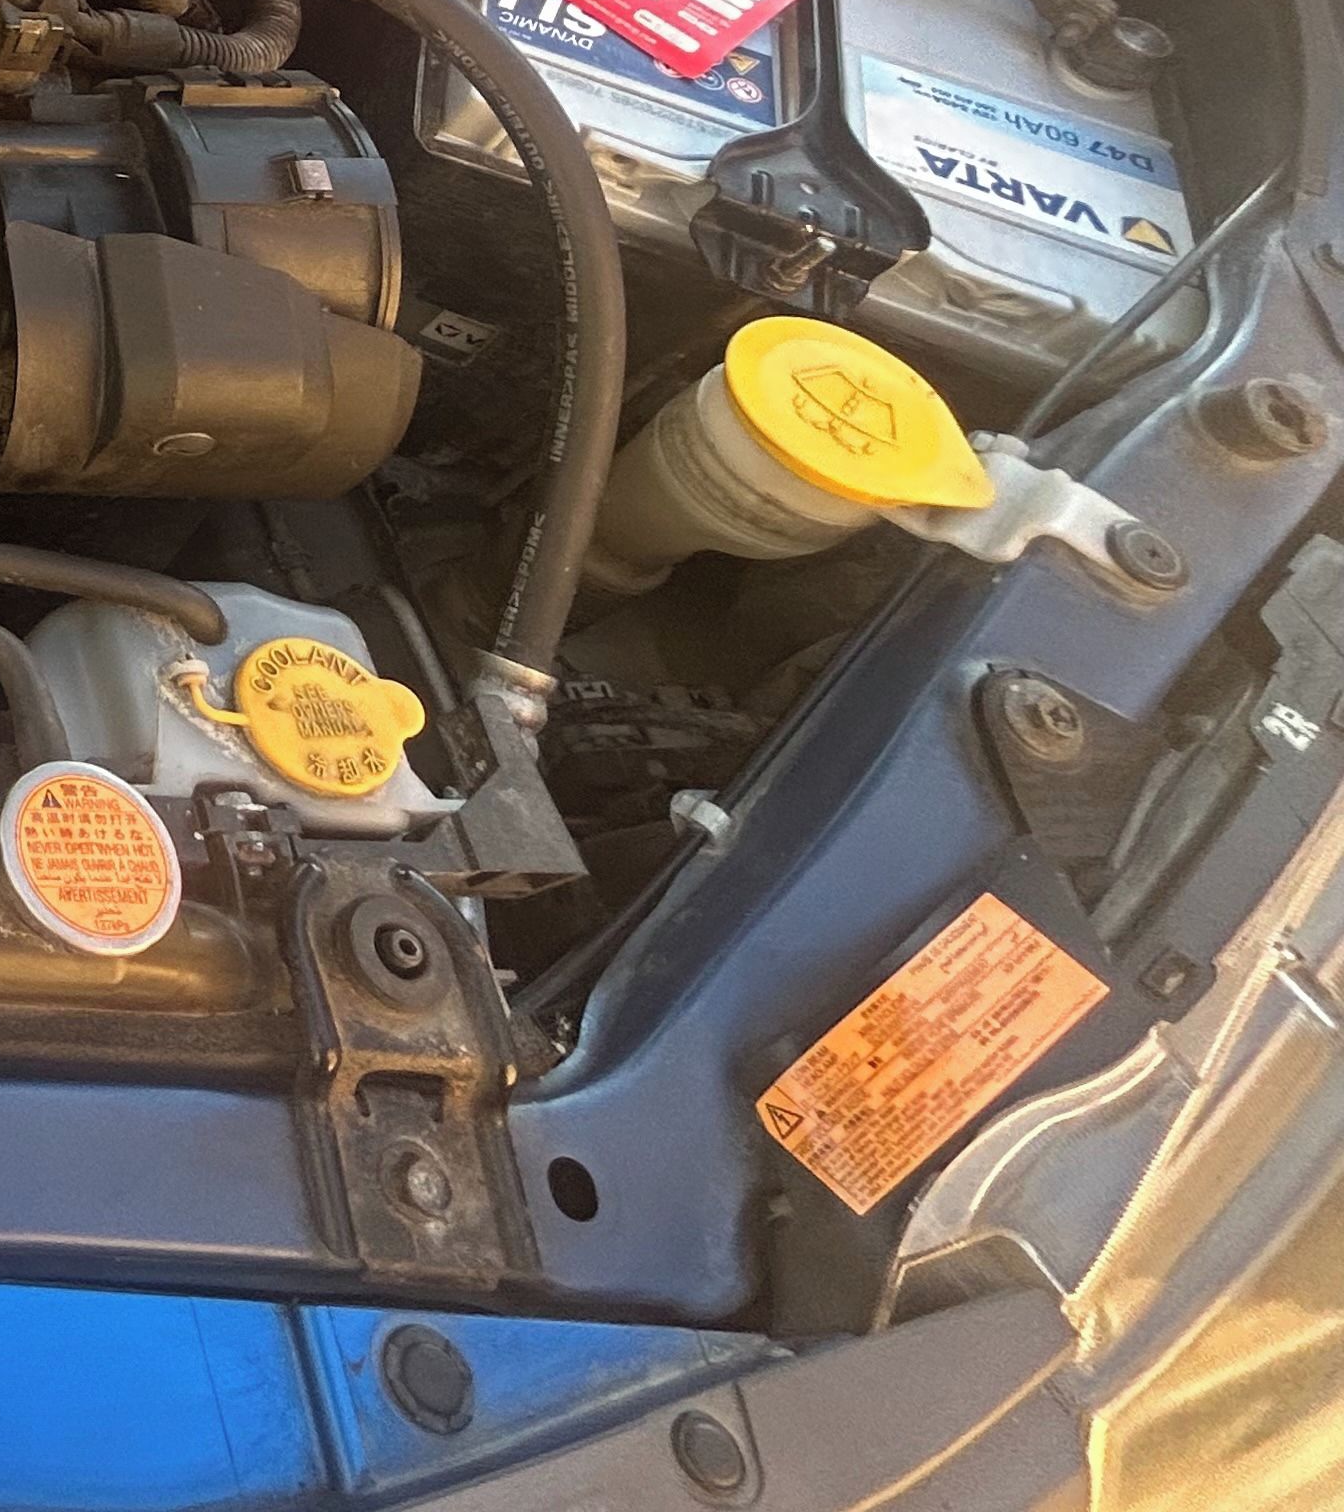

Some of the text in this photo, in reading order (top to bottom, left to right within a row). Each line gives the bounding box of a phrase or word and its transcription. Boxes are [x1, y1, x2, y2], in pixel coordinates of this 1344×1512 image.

[499, 10, 595, 51] DYNAMIC
[1004, 109, 1155, 173] D47 60Ah
[915, 145, 1110, 235] VARTA
[250, 643, 368, 694] COOLANT
[292, 682, 330, 702] SEE
[296, 717, 363, 738] MANUAL
[63, 798, 120, 811] WARNING
[27, 841, 62, 854] NEVER
[58, 886, 148, 905] AVERTISSEMENT
